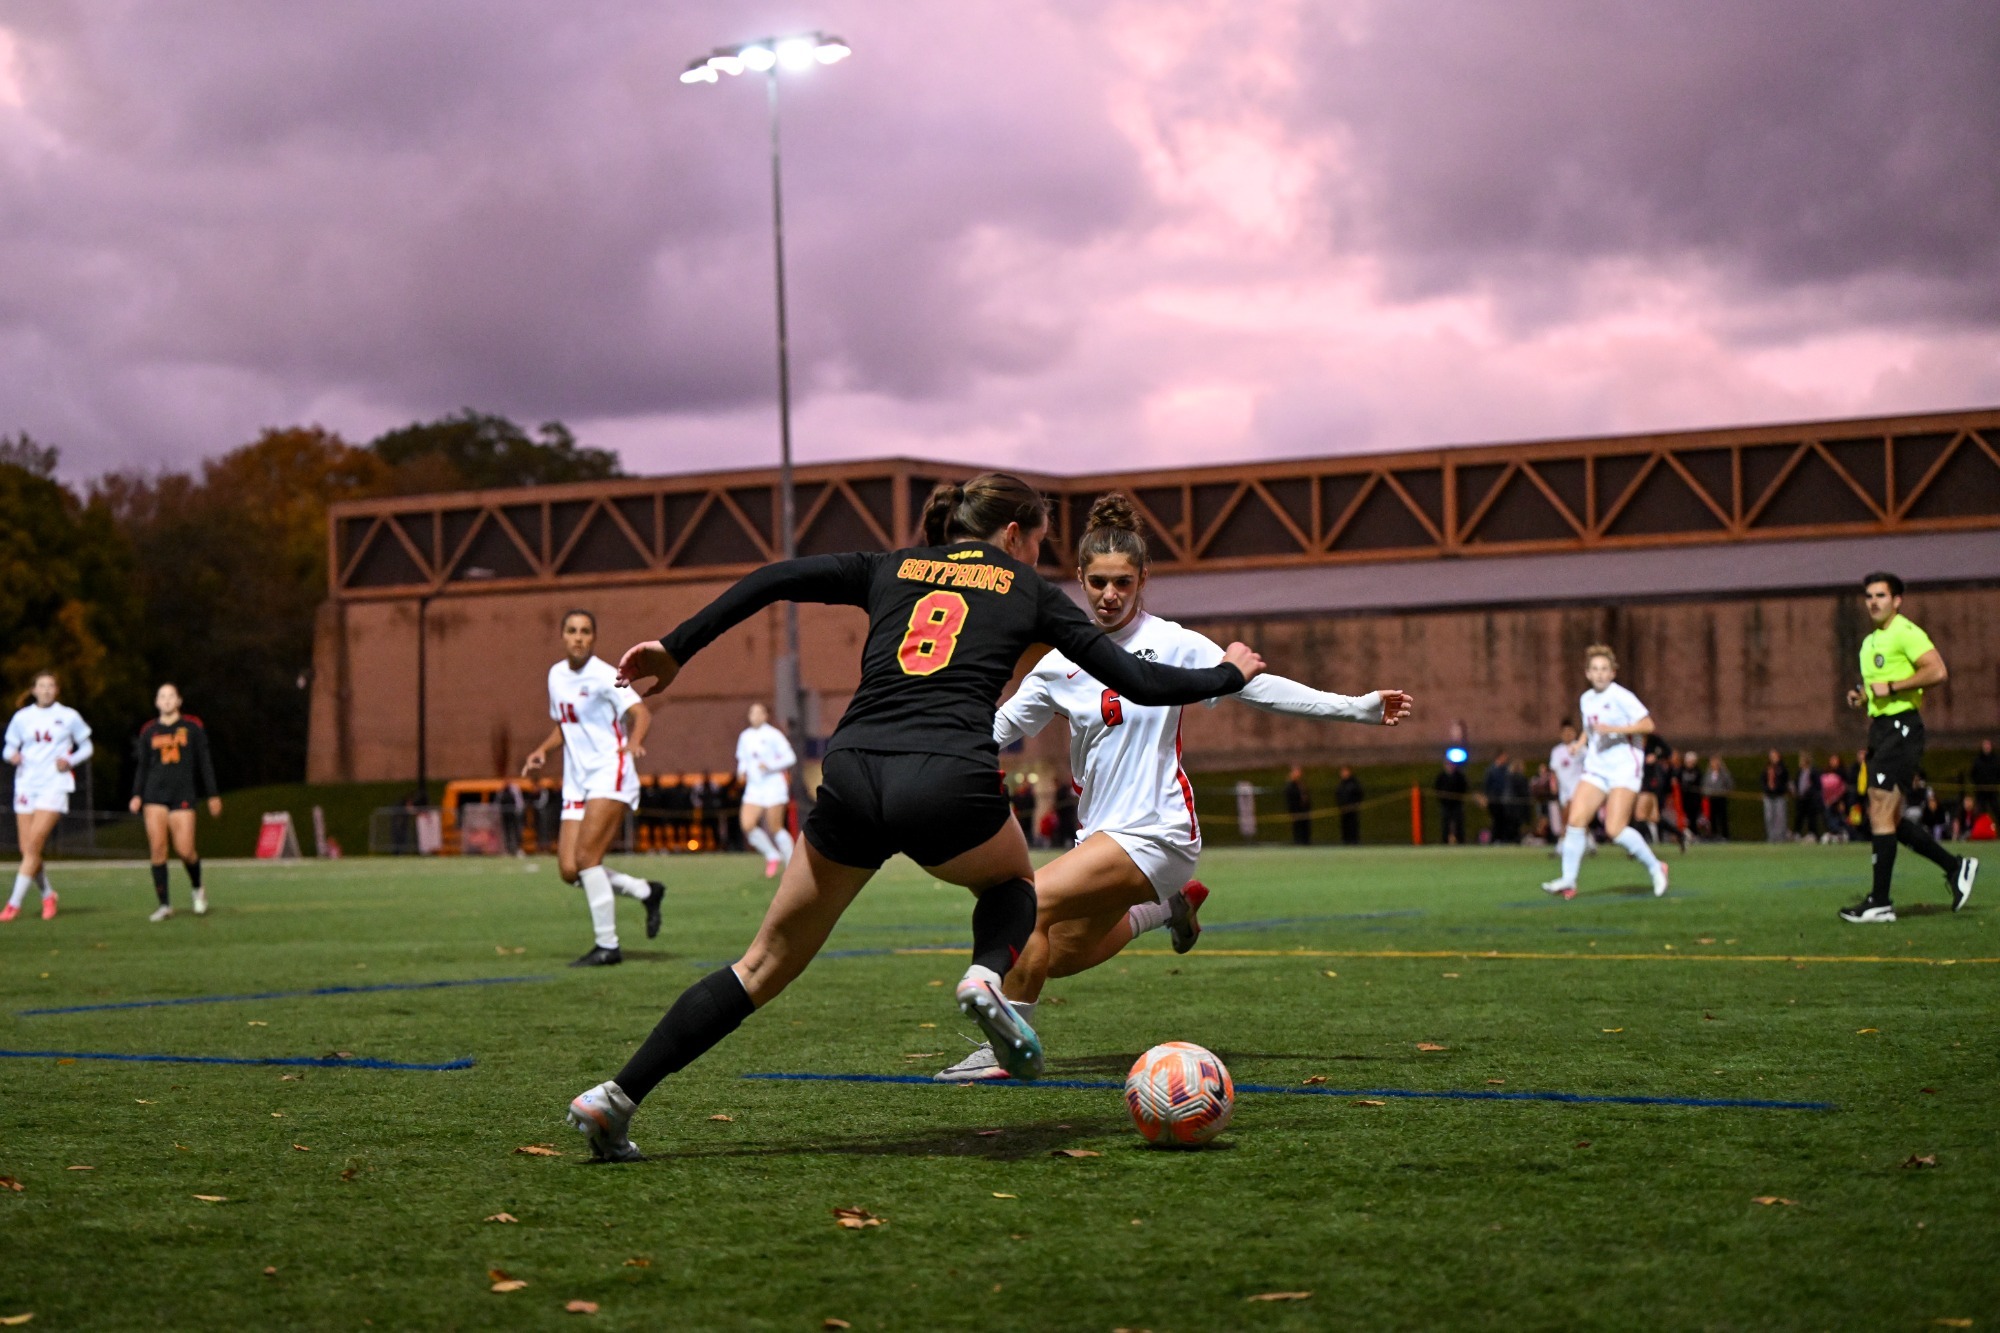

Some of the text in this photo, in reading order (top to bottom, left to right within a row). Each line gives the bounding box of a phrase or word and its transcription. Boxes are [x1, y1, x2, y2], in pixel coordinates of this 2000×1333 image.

[897, 558, 1014, 594] GRYPHONS
[897, 590, 969, 676] 8
[1101, 688, 1124, 727] 6
[35, 729, 52, 742] 14
